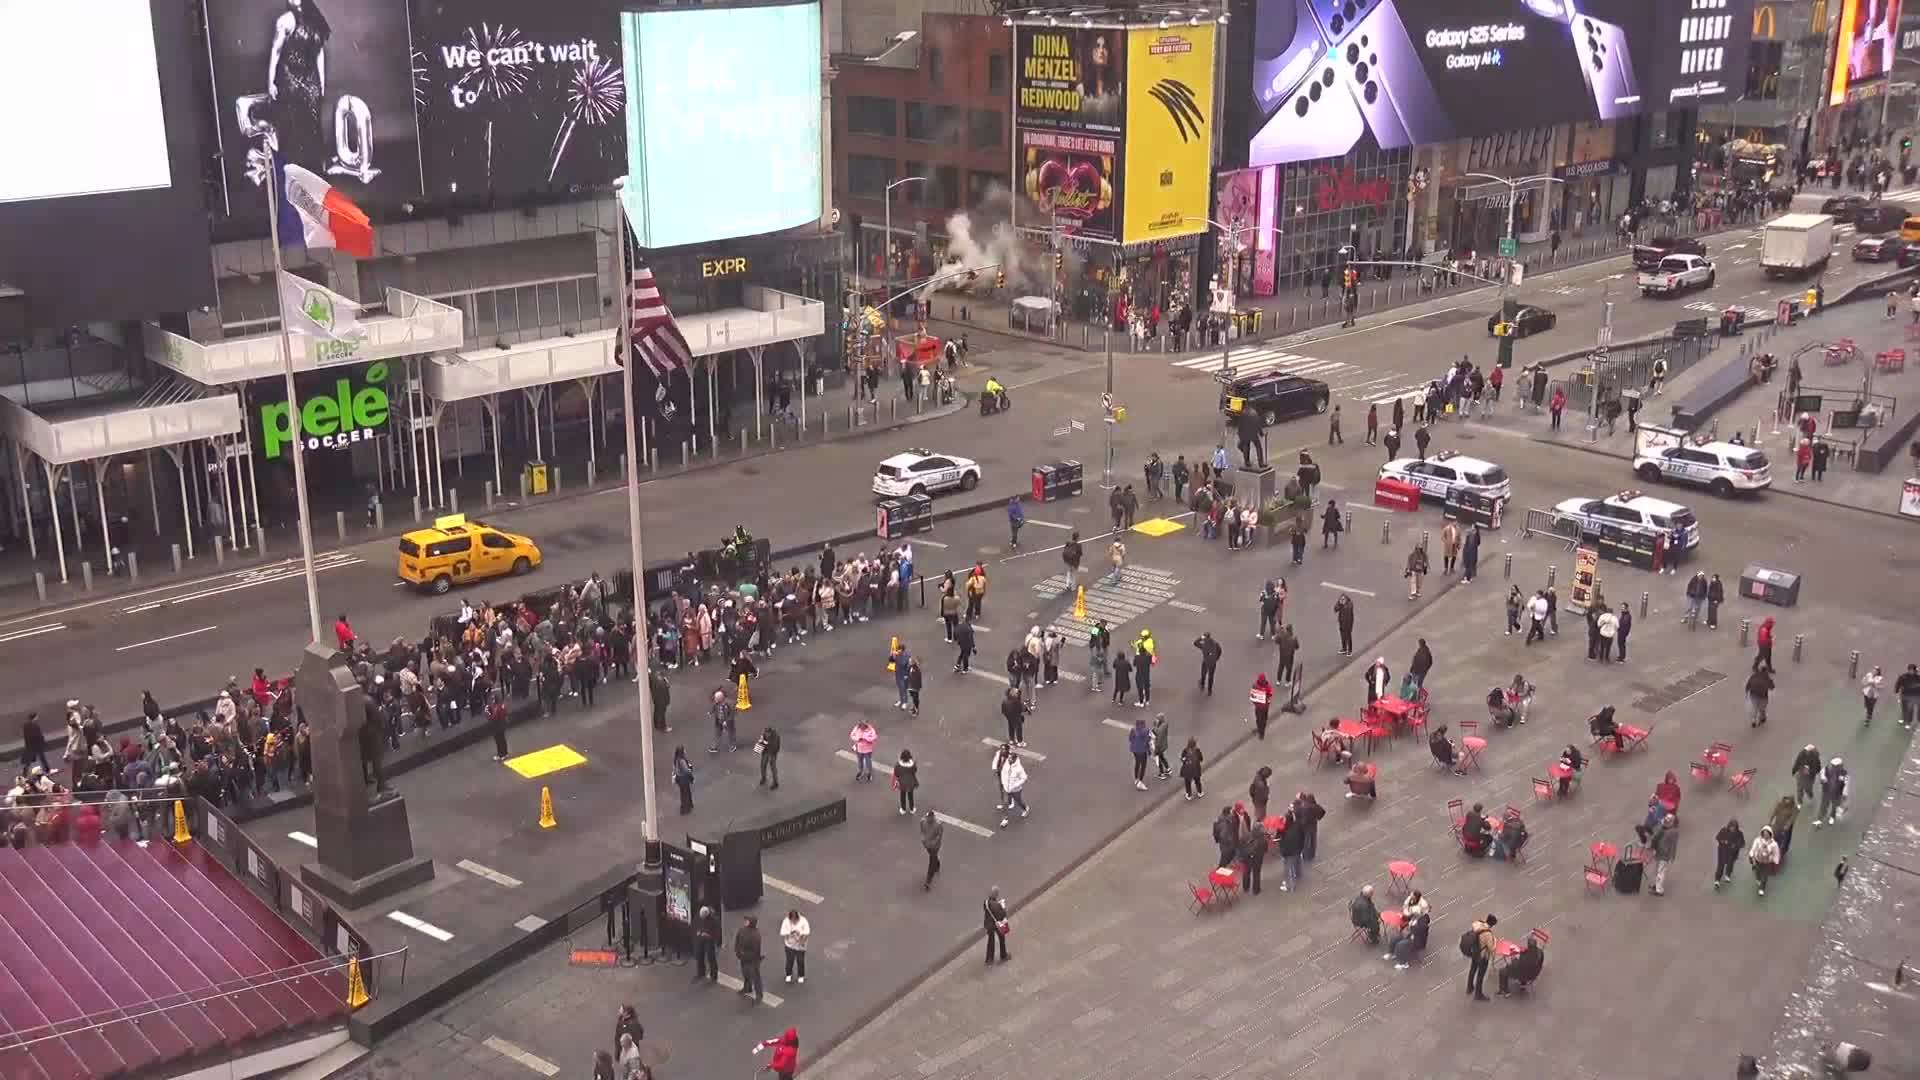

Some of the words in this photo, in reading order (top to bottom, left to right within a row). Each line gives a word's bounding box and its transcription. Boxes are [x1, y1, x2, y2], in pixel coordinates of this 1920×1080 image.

[1033, 34, 1068, 57] IDINA
[1426, 29, 1469, 49] Galaxy
[1469, 26, 1490, 44] S25
[1490, 22, 1525, 42] Series
[442, 45, 480, 68] We
[487, 41, 545, 66] can't
[550, 38, 600, 62] wait
[1446, 53, 1481, 70] Galaxy
[1024, 57, 1077, 81] MENZEL
[452, 84, 477, 108] to
[1021, 87, 1080, 112] REDWOOD
[1466, 128, 1552, 173] FOREVER
[703, 257, 746, 277] EXPR
